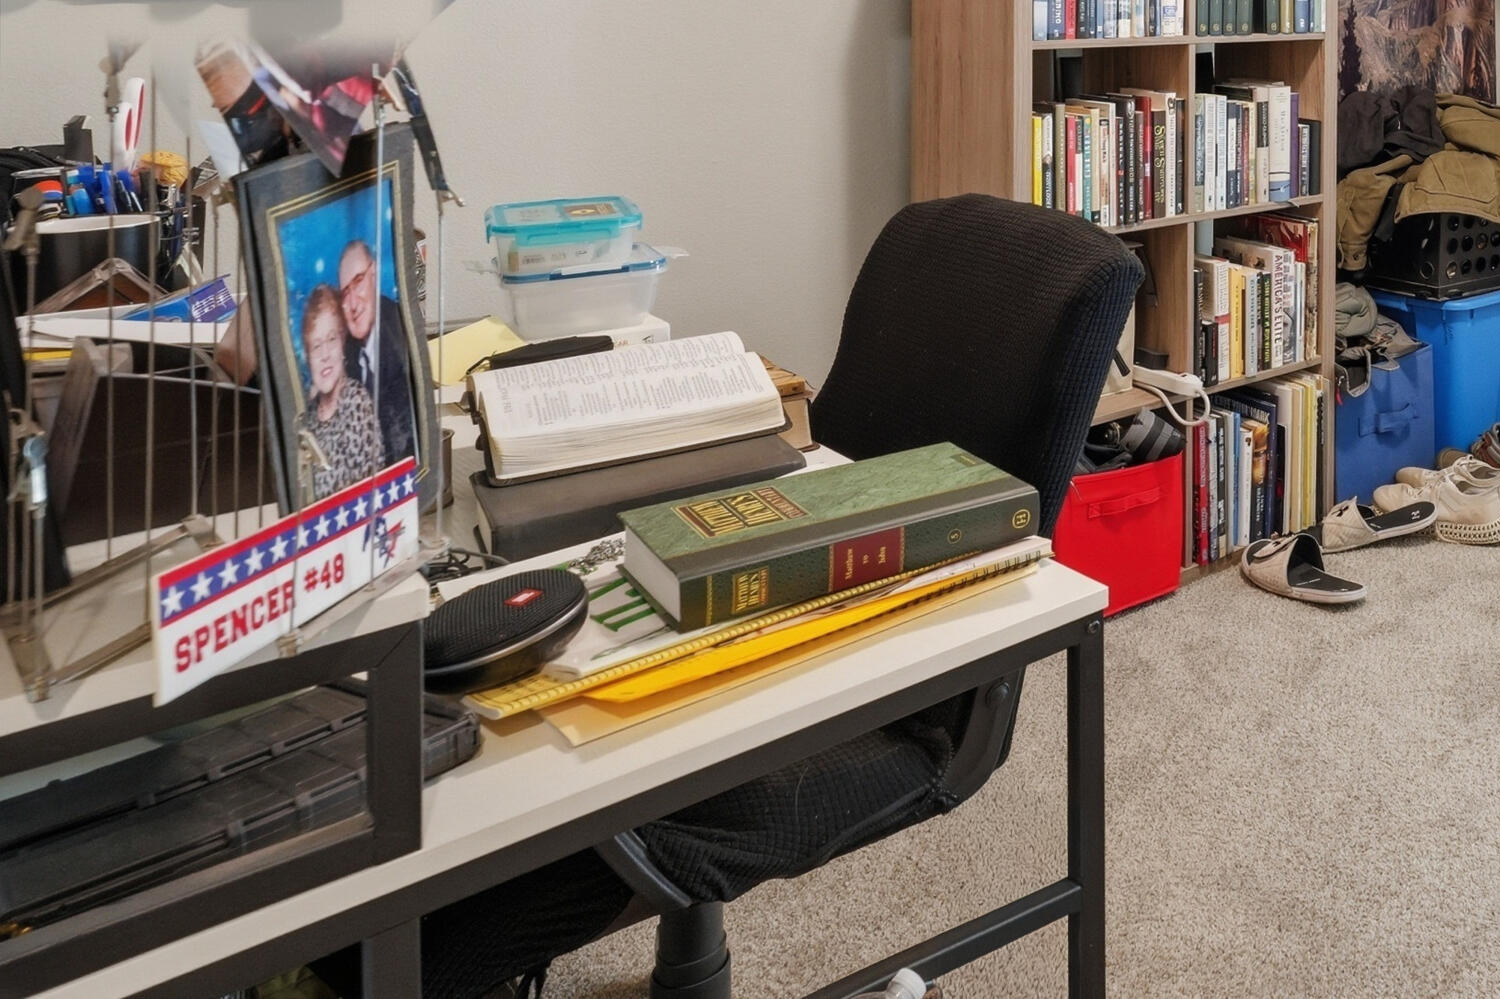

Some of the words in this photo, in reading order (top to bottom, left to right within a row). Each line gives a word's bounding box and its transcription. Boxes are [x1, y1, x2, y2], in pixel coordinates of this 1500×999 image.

[1273, 255, 1283, 313] AMERICA'S
[1273, 315, 1283, 343] ELITE
[175, 579, 296, 673] SPENCER
[304, 553, 344, 592] #48
